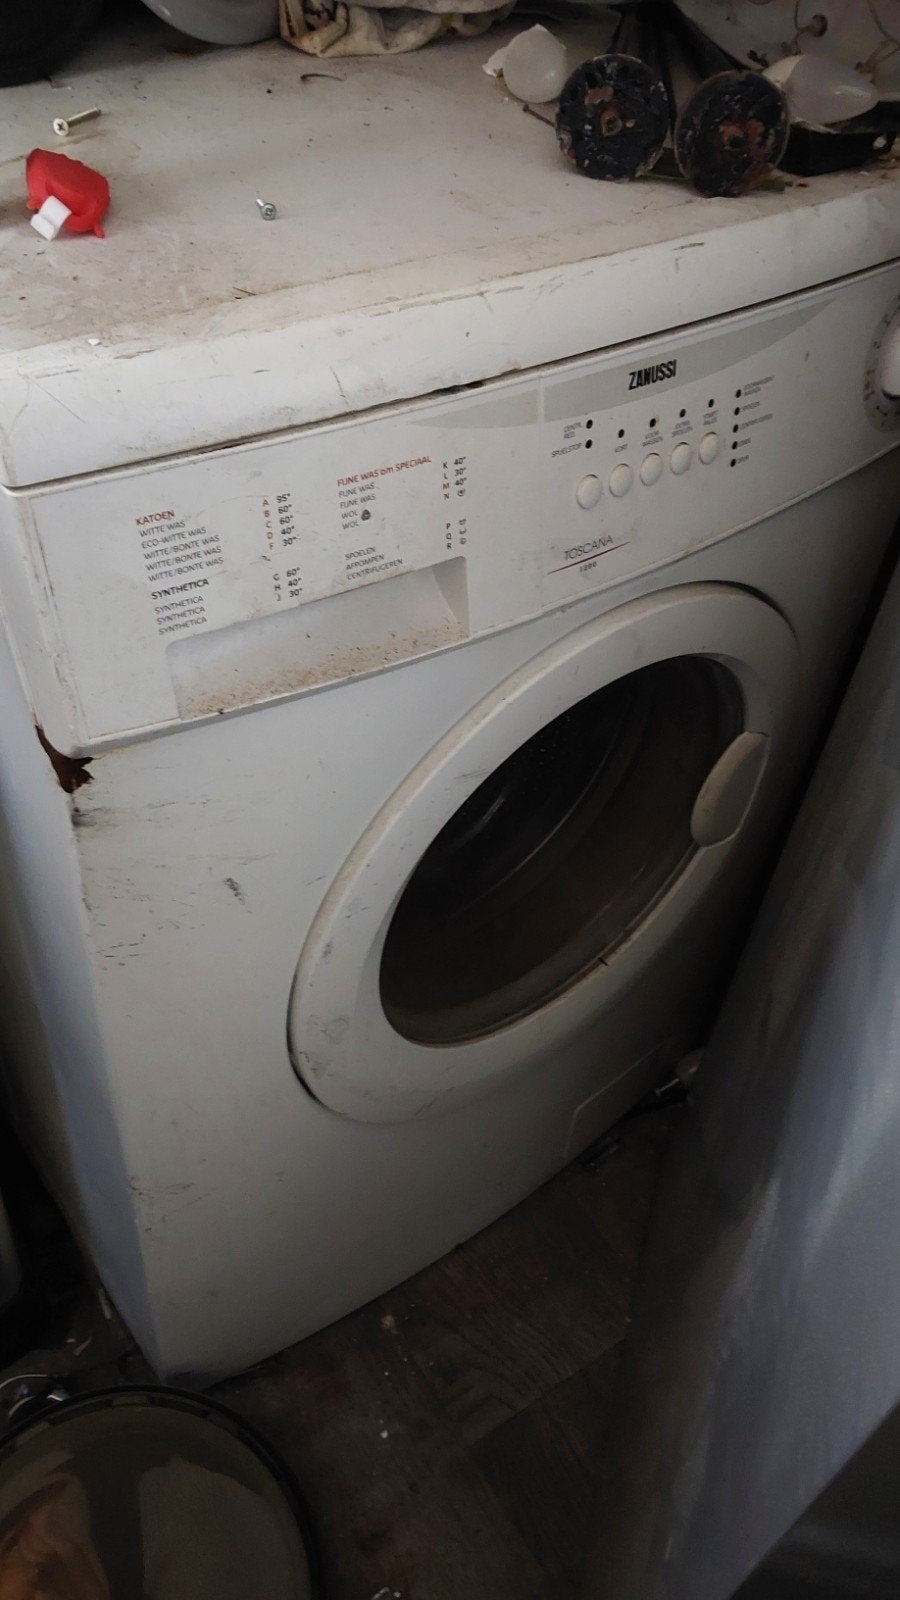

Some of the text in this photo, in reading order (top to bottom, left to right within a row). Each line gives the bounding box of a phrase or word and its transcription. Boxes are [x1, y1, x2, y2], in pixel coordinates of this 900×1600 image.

[628, 359, 677, 391] ZANUSSI
[361, 470, 379, 480] WAS
[395, 455, 432, 472] SPECIAAL
[262, 499, 269, 507] A
[135, 509, 175, 526] KATOEN
[342, 510, 358, 520] WOL
[139, 520, 186, 538] WITTE WAS
[342, 520, 359, 530] WOL
[141, 527, 207, 549] ECO-WITTE WAS
[144, 535, 220, 561] WITTE/BONTE WAS
[344, 546, 376, 560] SPOELEN
[563, 535, 614, 561] TOSCANA
[146, 546, 222, 572] WITTE/BONTE WAS
[346, 554, 385, 570] AFPOMPEN
[148, 557, 224, 583] WITTE/BONTE WAS
[151, 578, 209, 600] SYNTHETICA
[154, 596, 204, 615] SYNTHETICA
[156, 607, 206, 625] SYNTHETICA
[158, 617, 207, 636] SYNTHETICA
